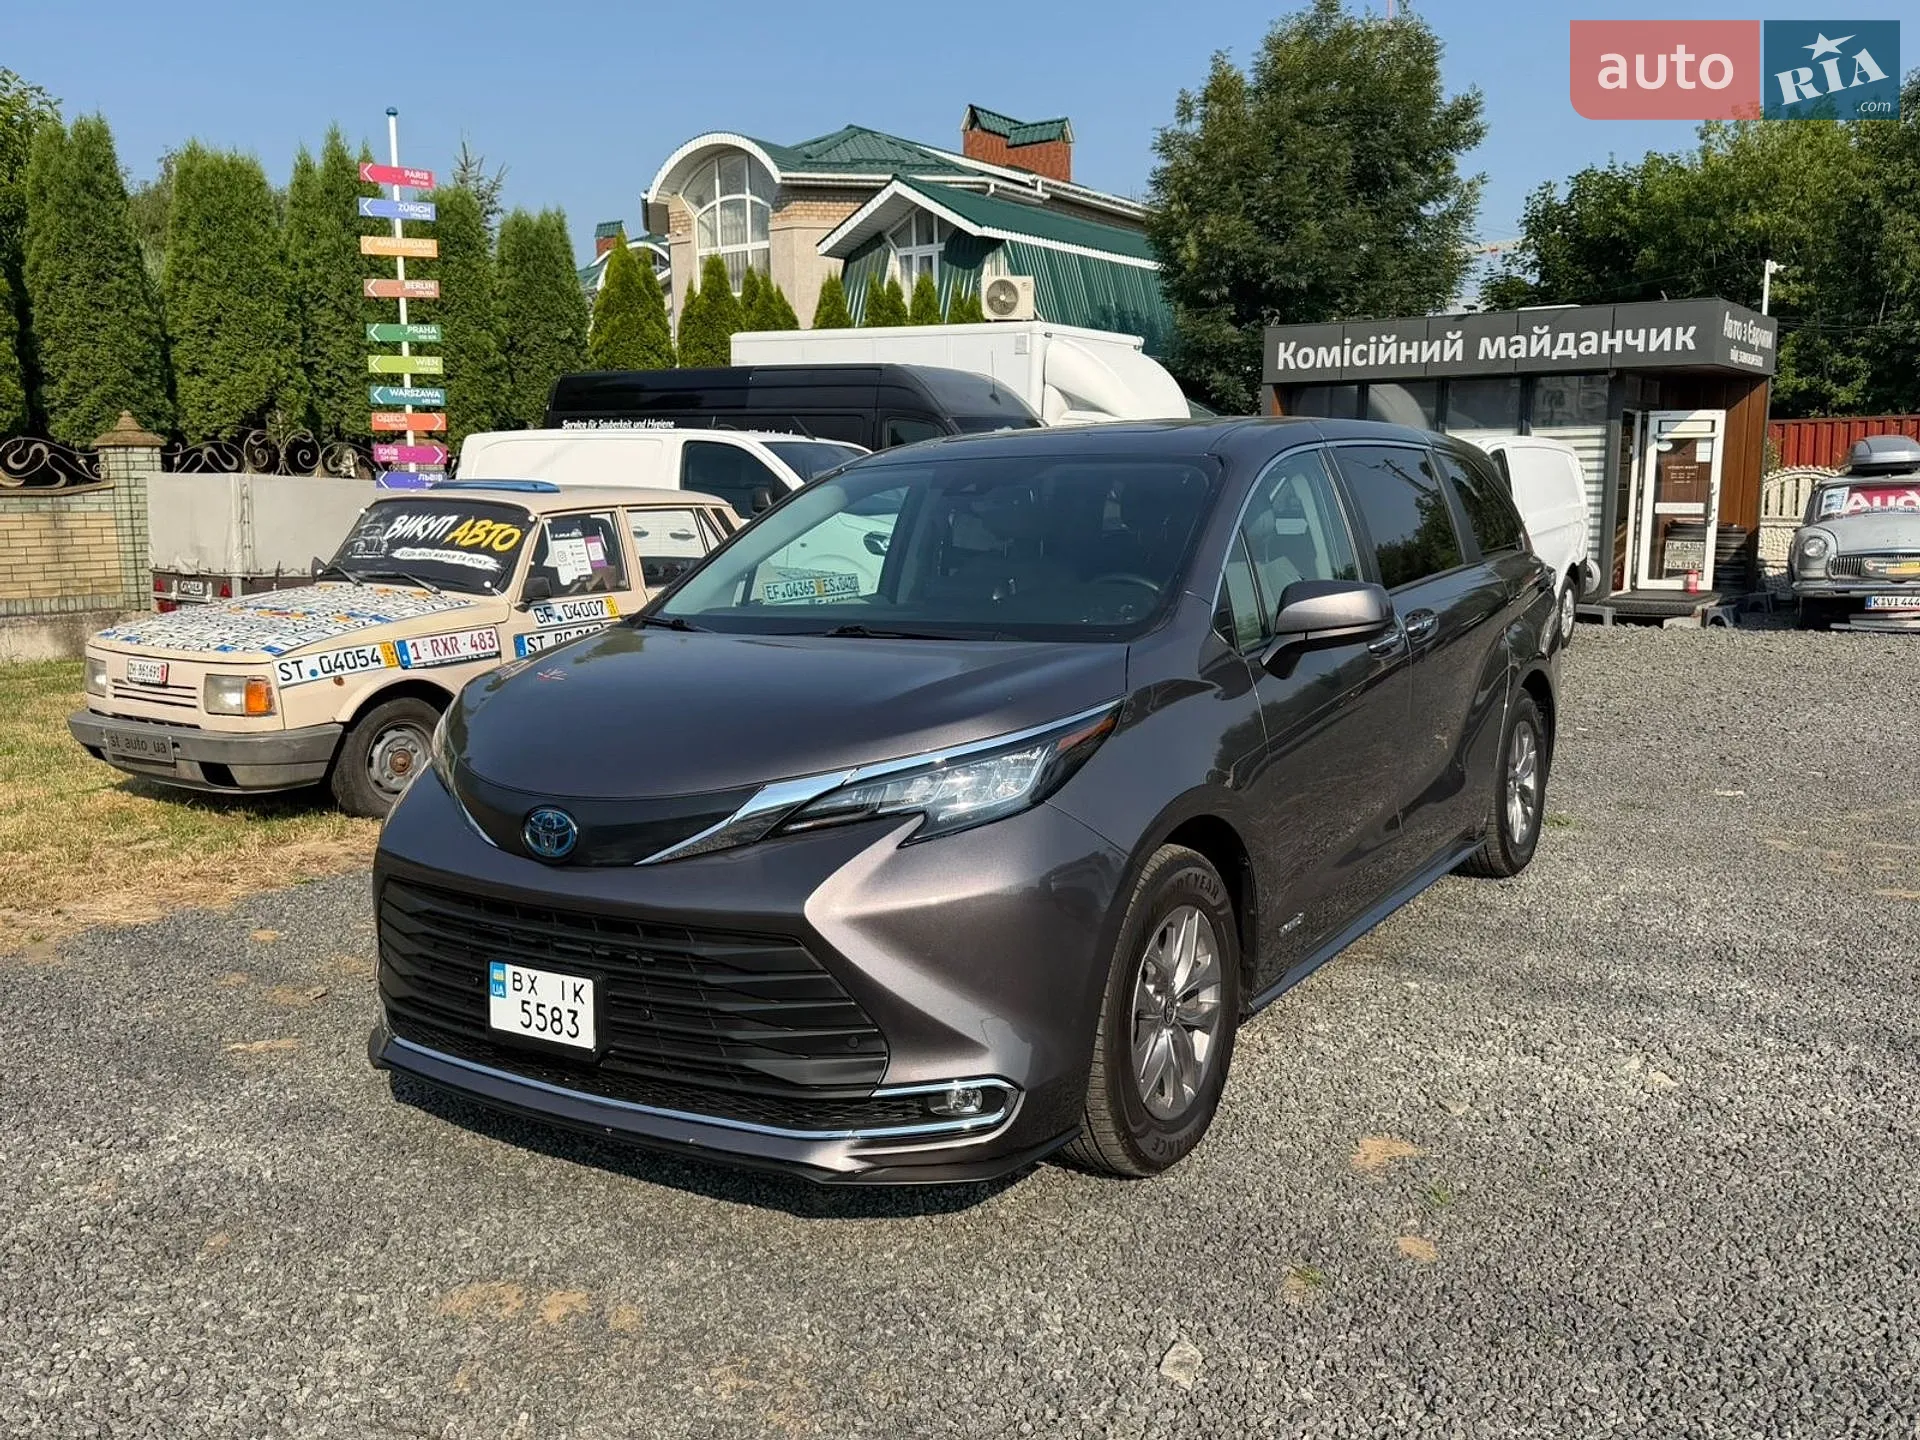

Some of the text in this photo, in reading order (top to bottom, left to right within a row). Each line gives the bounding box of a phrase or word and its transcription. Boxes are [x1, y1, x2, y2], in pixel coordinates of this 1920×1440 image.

[404, 169, 429, 180] PARIS
[404, 280, 435, 290] BERLIN
[407, 325, 437, 335] PRAHA
[1277, 324, 1697, 370] Комісійний майданчик
[415, 358, 439, 366] WIEN
[389, 388, 441, 398] WARSZAWA
[376, 415, 407, 424] ОДЕСА
[562, 419, 587, 430] Service
[598, 418, 633, 430] Sauberkeit
[633, 419, 647, 429] und
[384, 514, 522, 552] ВИКУП АВТО
[493, 983, 505, 996] UA
[512, 971, 585, 1005] BX IK
[520, 1000, 580, 1039] 5583
